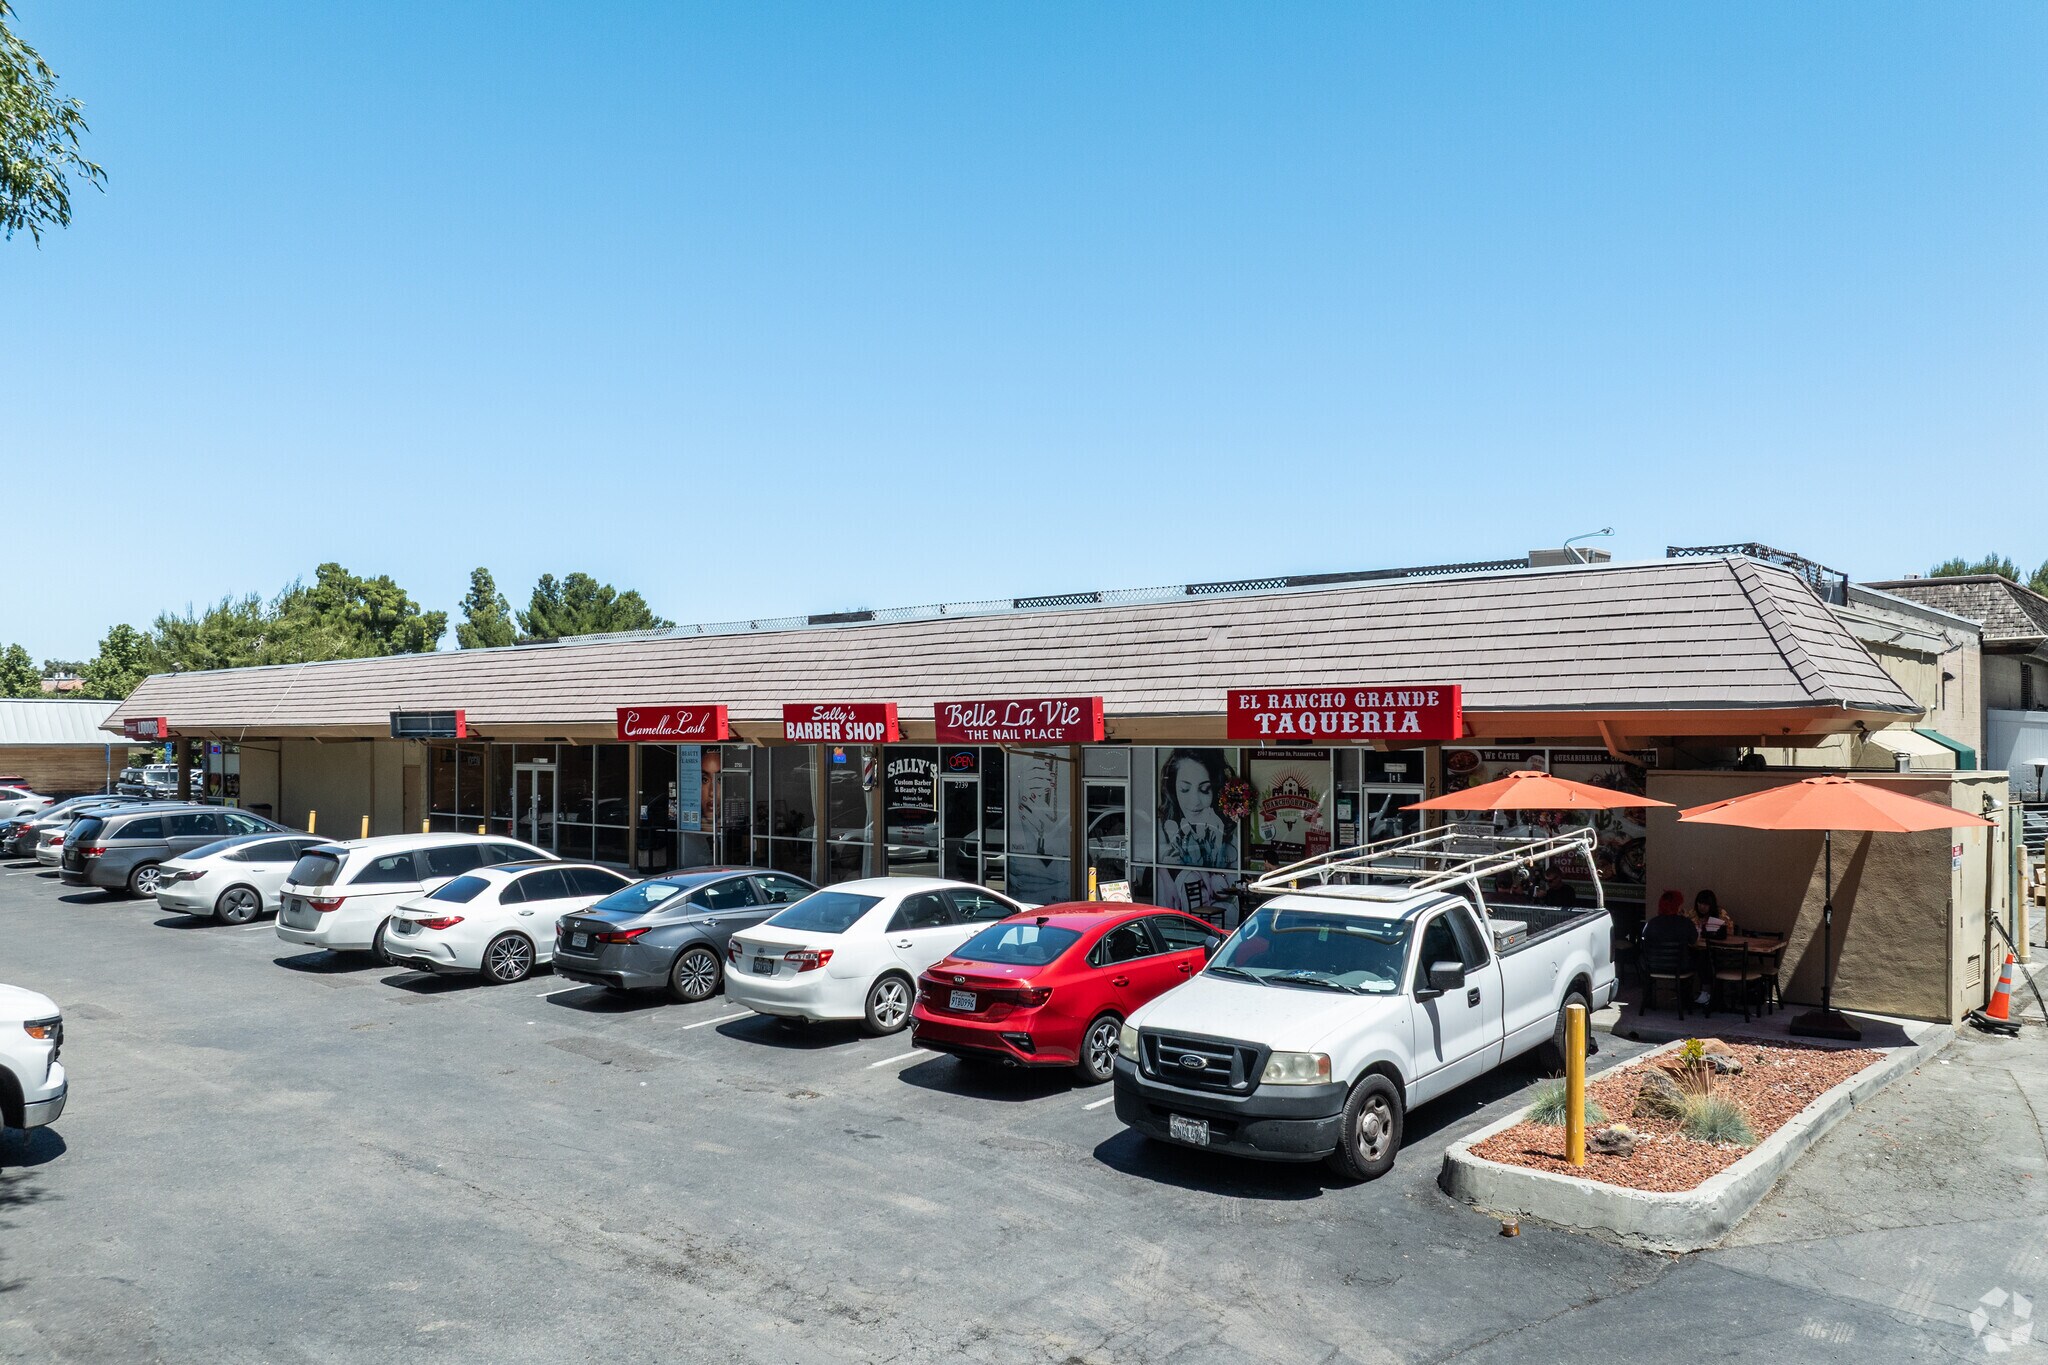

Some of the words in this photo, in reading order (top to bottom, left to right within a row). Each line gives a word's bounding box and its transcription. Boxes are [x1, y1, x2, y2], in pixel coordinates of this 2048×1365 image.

[1239, 694, 1261, 709] EL
[1267, 692, 1346, 709] RANCHO
[1354, 691, 1439, 708] GRANDE
[624, 710, 673, 736] Camellia
[671, 710, 710, 735] Lash
[811, 705, 857, 725] Sally's
[945, 703, 997, 728] Belle
[1001, 702, 1036, 727] La
[1039, 701, 1081, 726] Vie
[1254, 711, 1422, 735] TAQUERIA
[786, 722, 841, 740] BARBER
[845, 722, 885, 740] SHOP
[993, 729, 1021, 740] NAIL
[887, 758, 938, 779] SALLY'S
[948, 755, 974, 767] OPEN
[900, 787, 917, 795] Beauty
[917, 787, 931, 795] Shop
[1558, 866, 1590, 875] KILLETS
